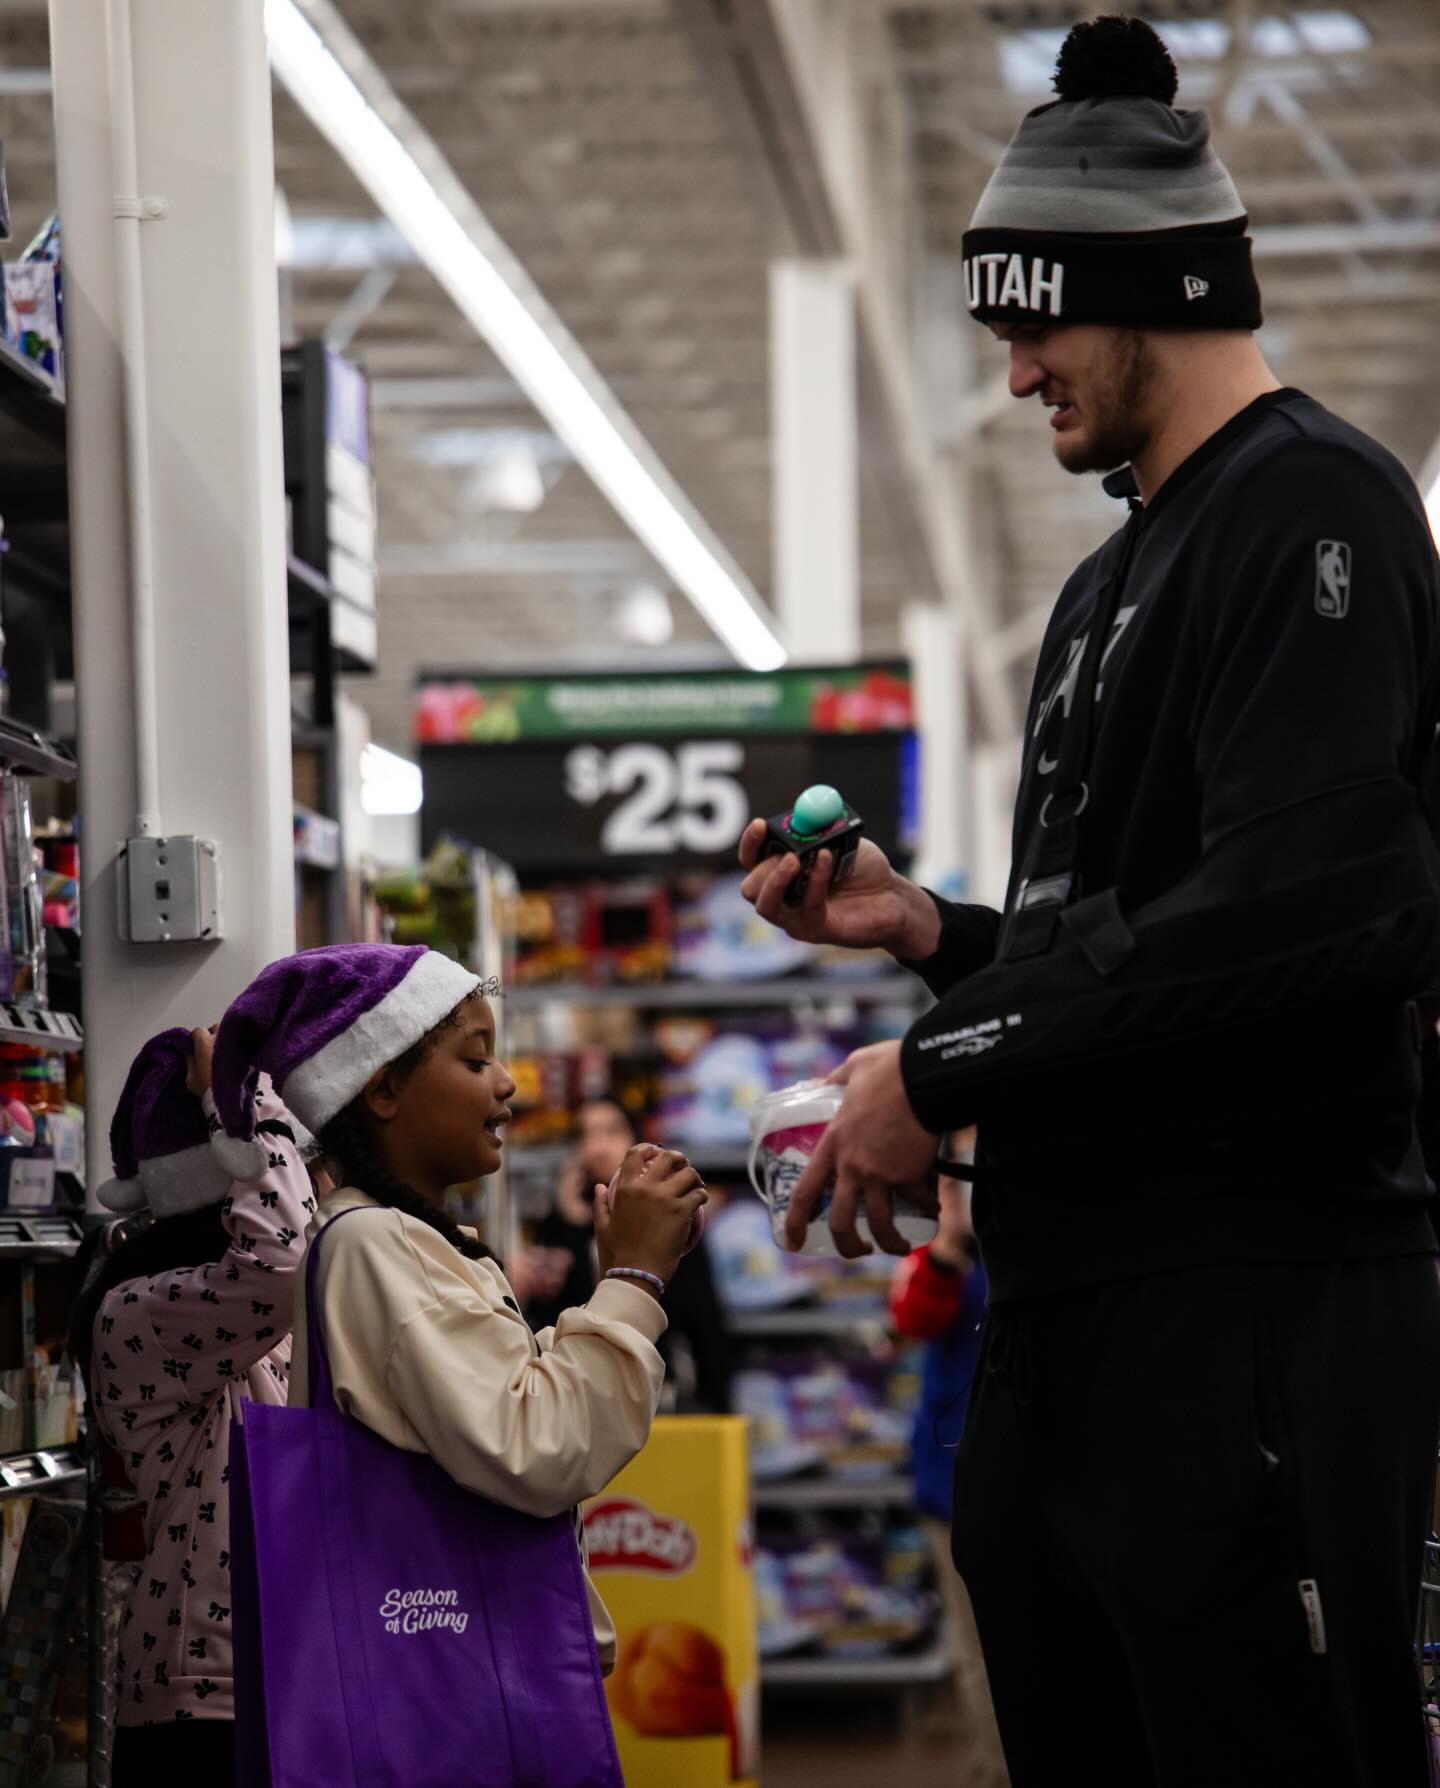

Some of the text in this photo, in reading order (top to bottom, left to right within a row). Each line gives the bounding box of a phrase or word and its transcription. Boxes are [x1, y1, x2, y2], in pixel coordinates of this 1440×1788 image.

[963, 253, 1064, 317] UTAH
[565, 740, 750, 855] $25
[380, 1588, 459, 1617] Season
[385, 1606, 469, 1634] of Giving
